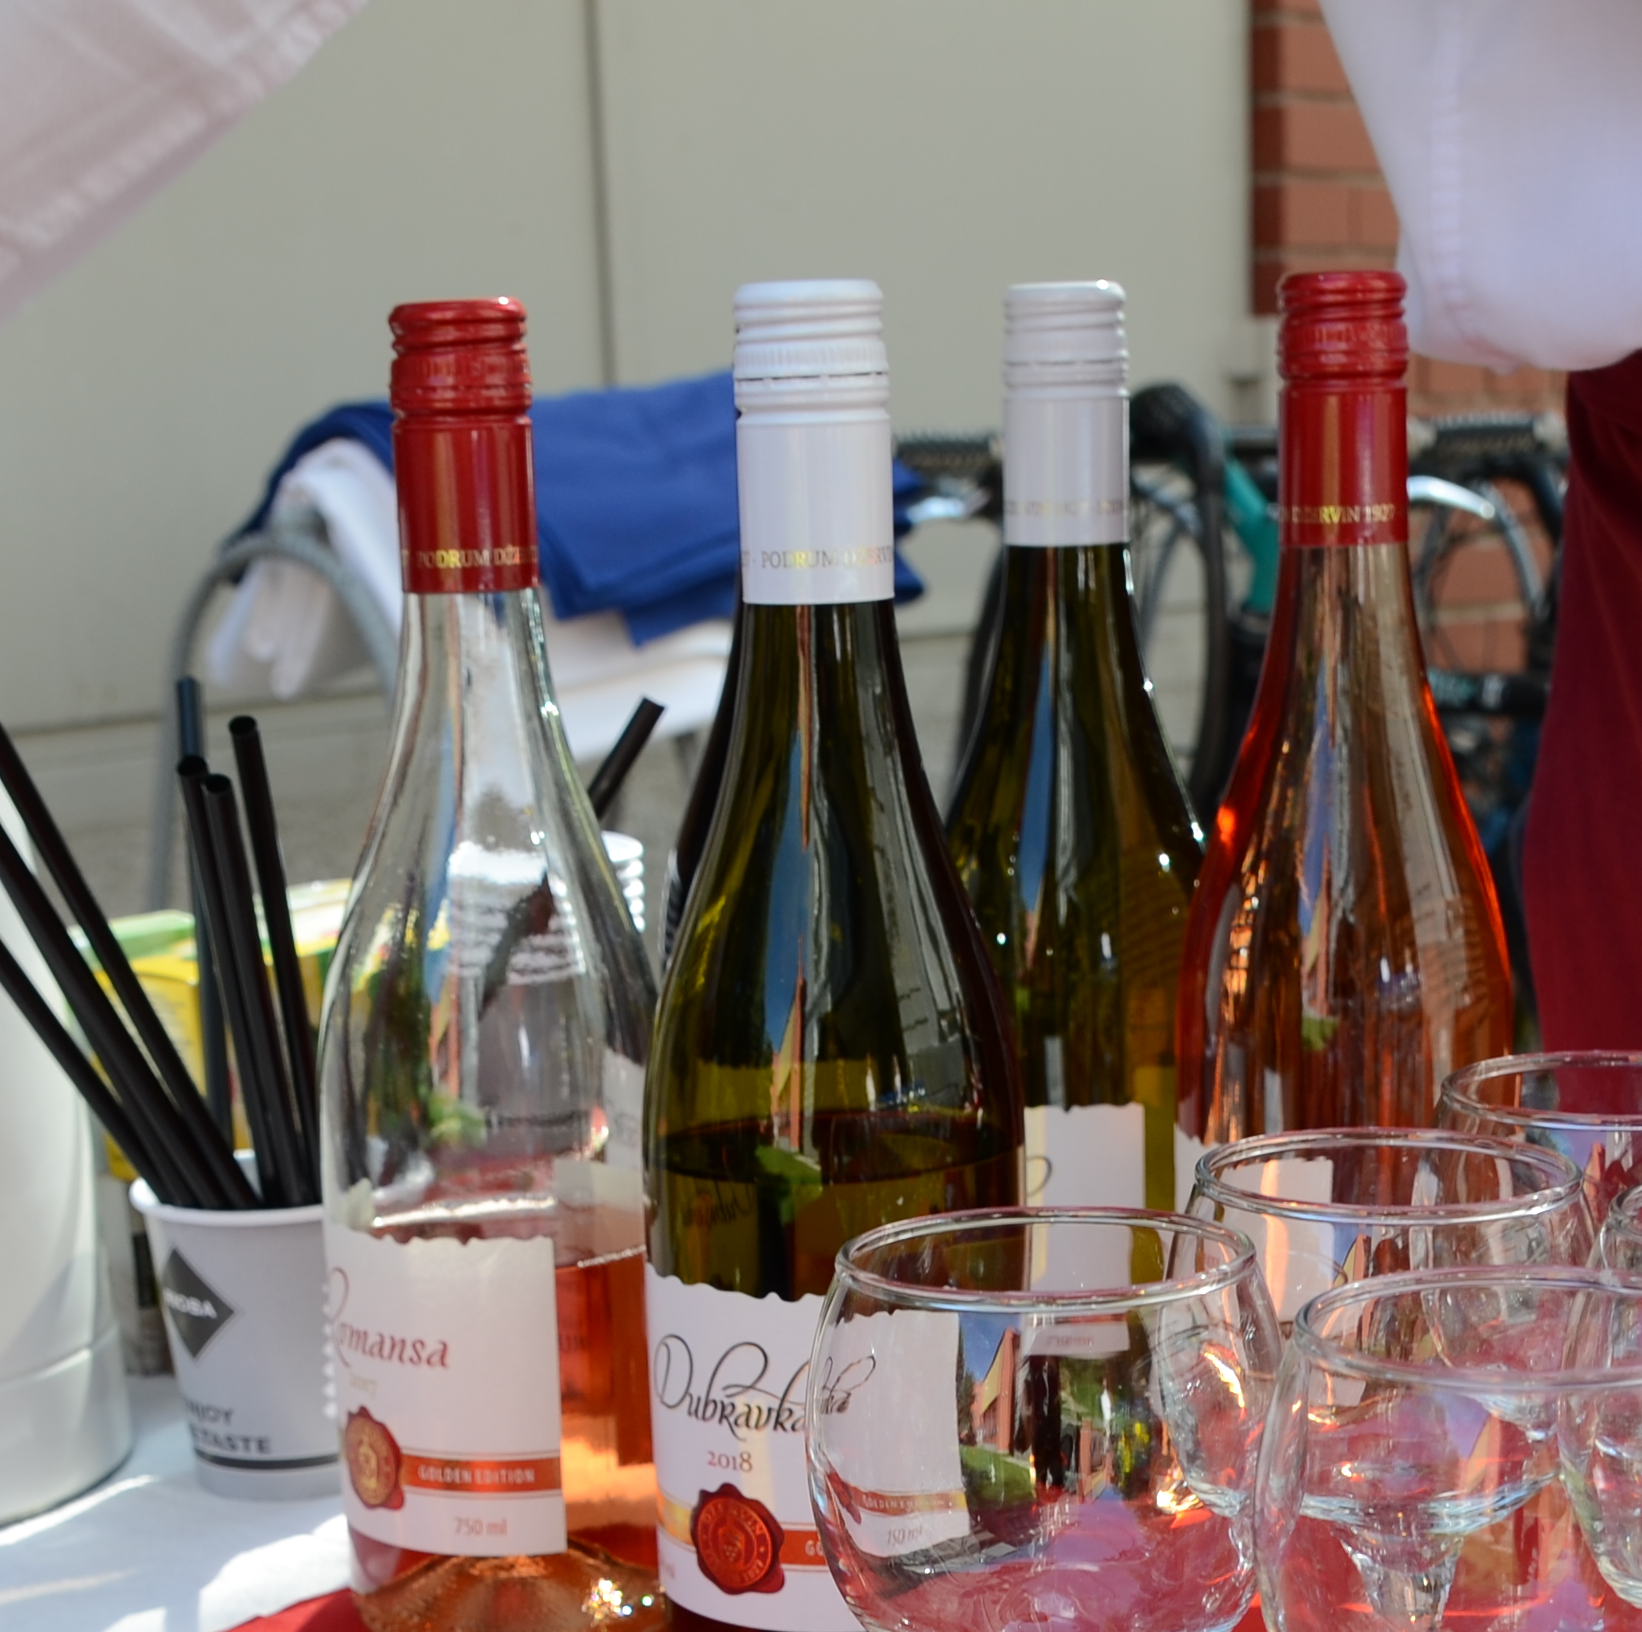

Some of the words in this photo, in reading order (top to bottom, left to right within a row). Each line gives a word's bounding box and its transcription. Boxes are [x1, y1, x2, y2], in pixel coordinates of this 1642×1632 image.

[707, 1451, 753, 1473] 2018
[417, 1463, 472, 1485] GOLDEN
[474, 1467, 536, 1485] EDITION
[454, 1516, 484, 1536] 750
[486, 1518, 508, 1536] ml
